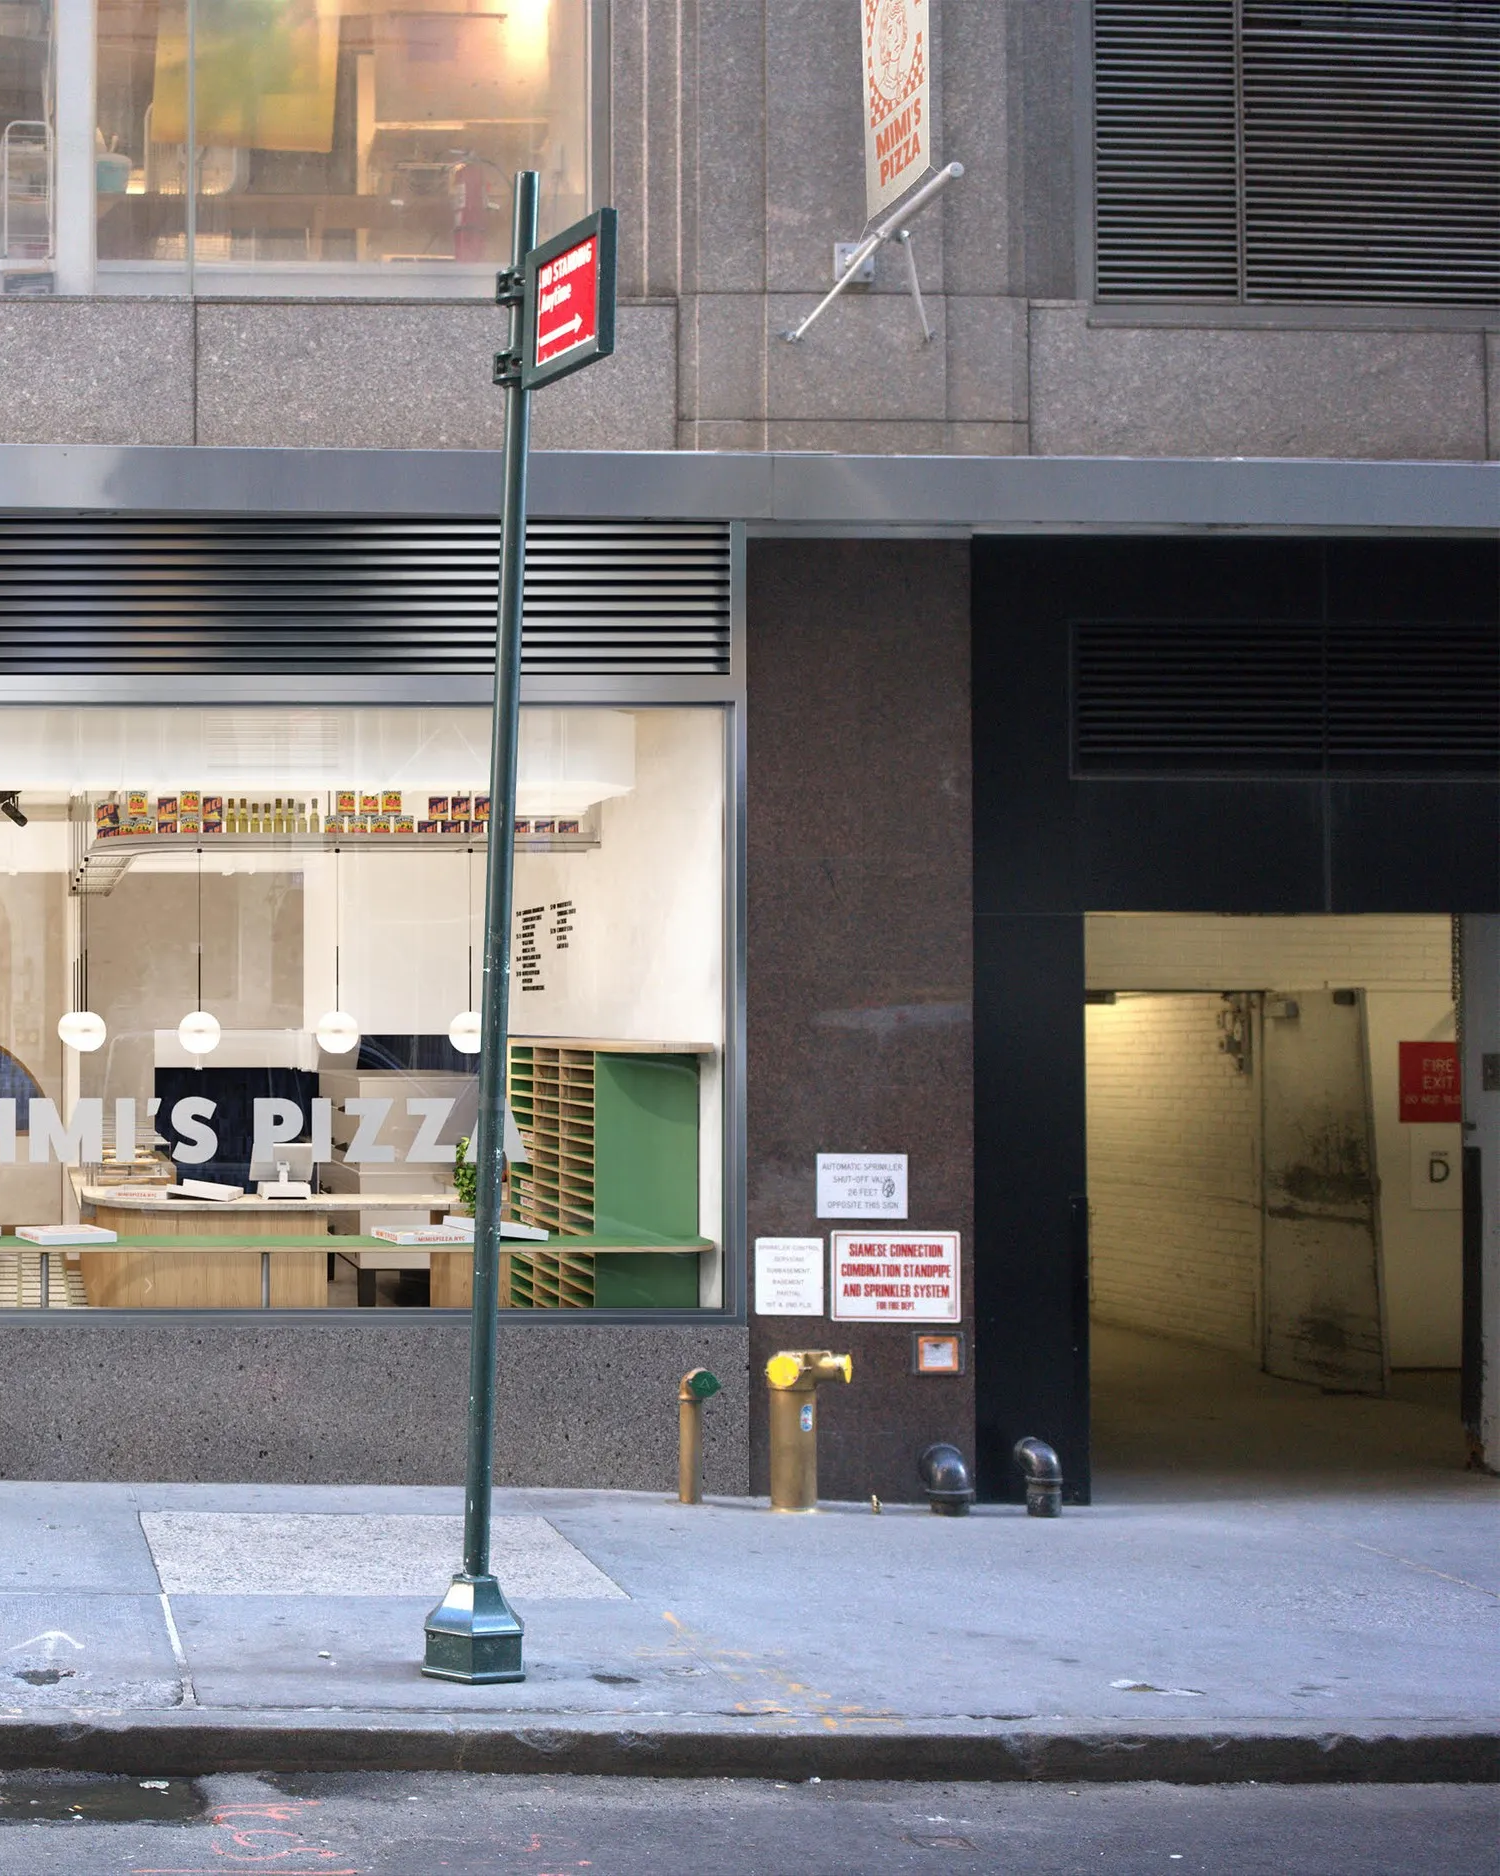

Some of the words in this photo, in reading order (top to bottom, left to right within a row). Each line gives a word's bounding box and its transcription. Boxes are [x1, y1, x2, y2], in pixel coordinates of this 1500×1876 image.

[876, 97, 921, 160] MIMI'S
[880, 132, 921, 187] PIZZA
[541, 265, 553, 289] NO
[553, 242, 592, 282] STANDING
[541, 284, 572, 313] Anytime
[1423, 1059, 1455, 1073] FIRE
[1423, 1076, 1454, 1090] EXIT
[254, 1098, 528, 1163] PIZZA
[822, 1163, 860, 1171] AUTOMATIC
[864, 1163, 903, 1171] SPRINKLER
[1429, 1159, 1450, 1183] D
[860, 1188, 878, 1196] FEET
[827, 1201, 862, 1209] OPPOSITE
[865, 1201, 880, 1209] THIS
[882, 1201, 899, 1209] SIGN
[849, 1244, 888, 1257] SIAMESE
[890, 1244, 943, 1257] CONNECTION
[841, 1264, 901, 1277] COMBINATION
[904, 1265, 951, 1278] STANDPIPE
[843, 1284, 861, 1297] AND
[864, 1284, 911, 1297] SPRINKLER
[914, 1285, 950, 1298] SYSTEM
[876, 1301, 887, 1310] FOR
[888, 1301, 899, 1310] FIRE
